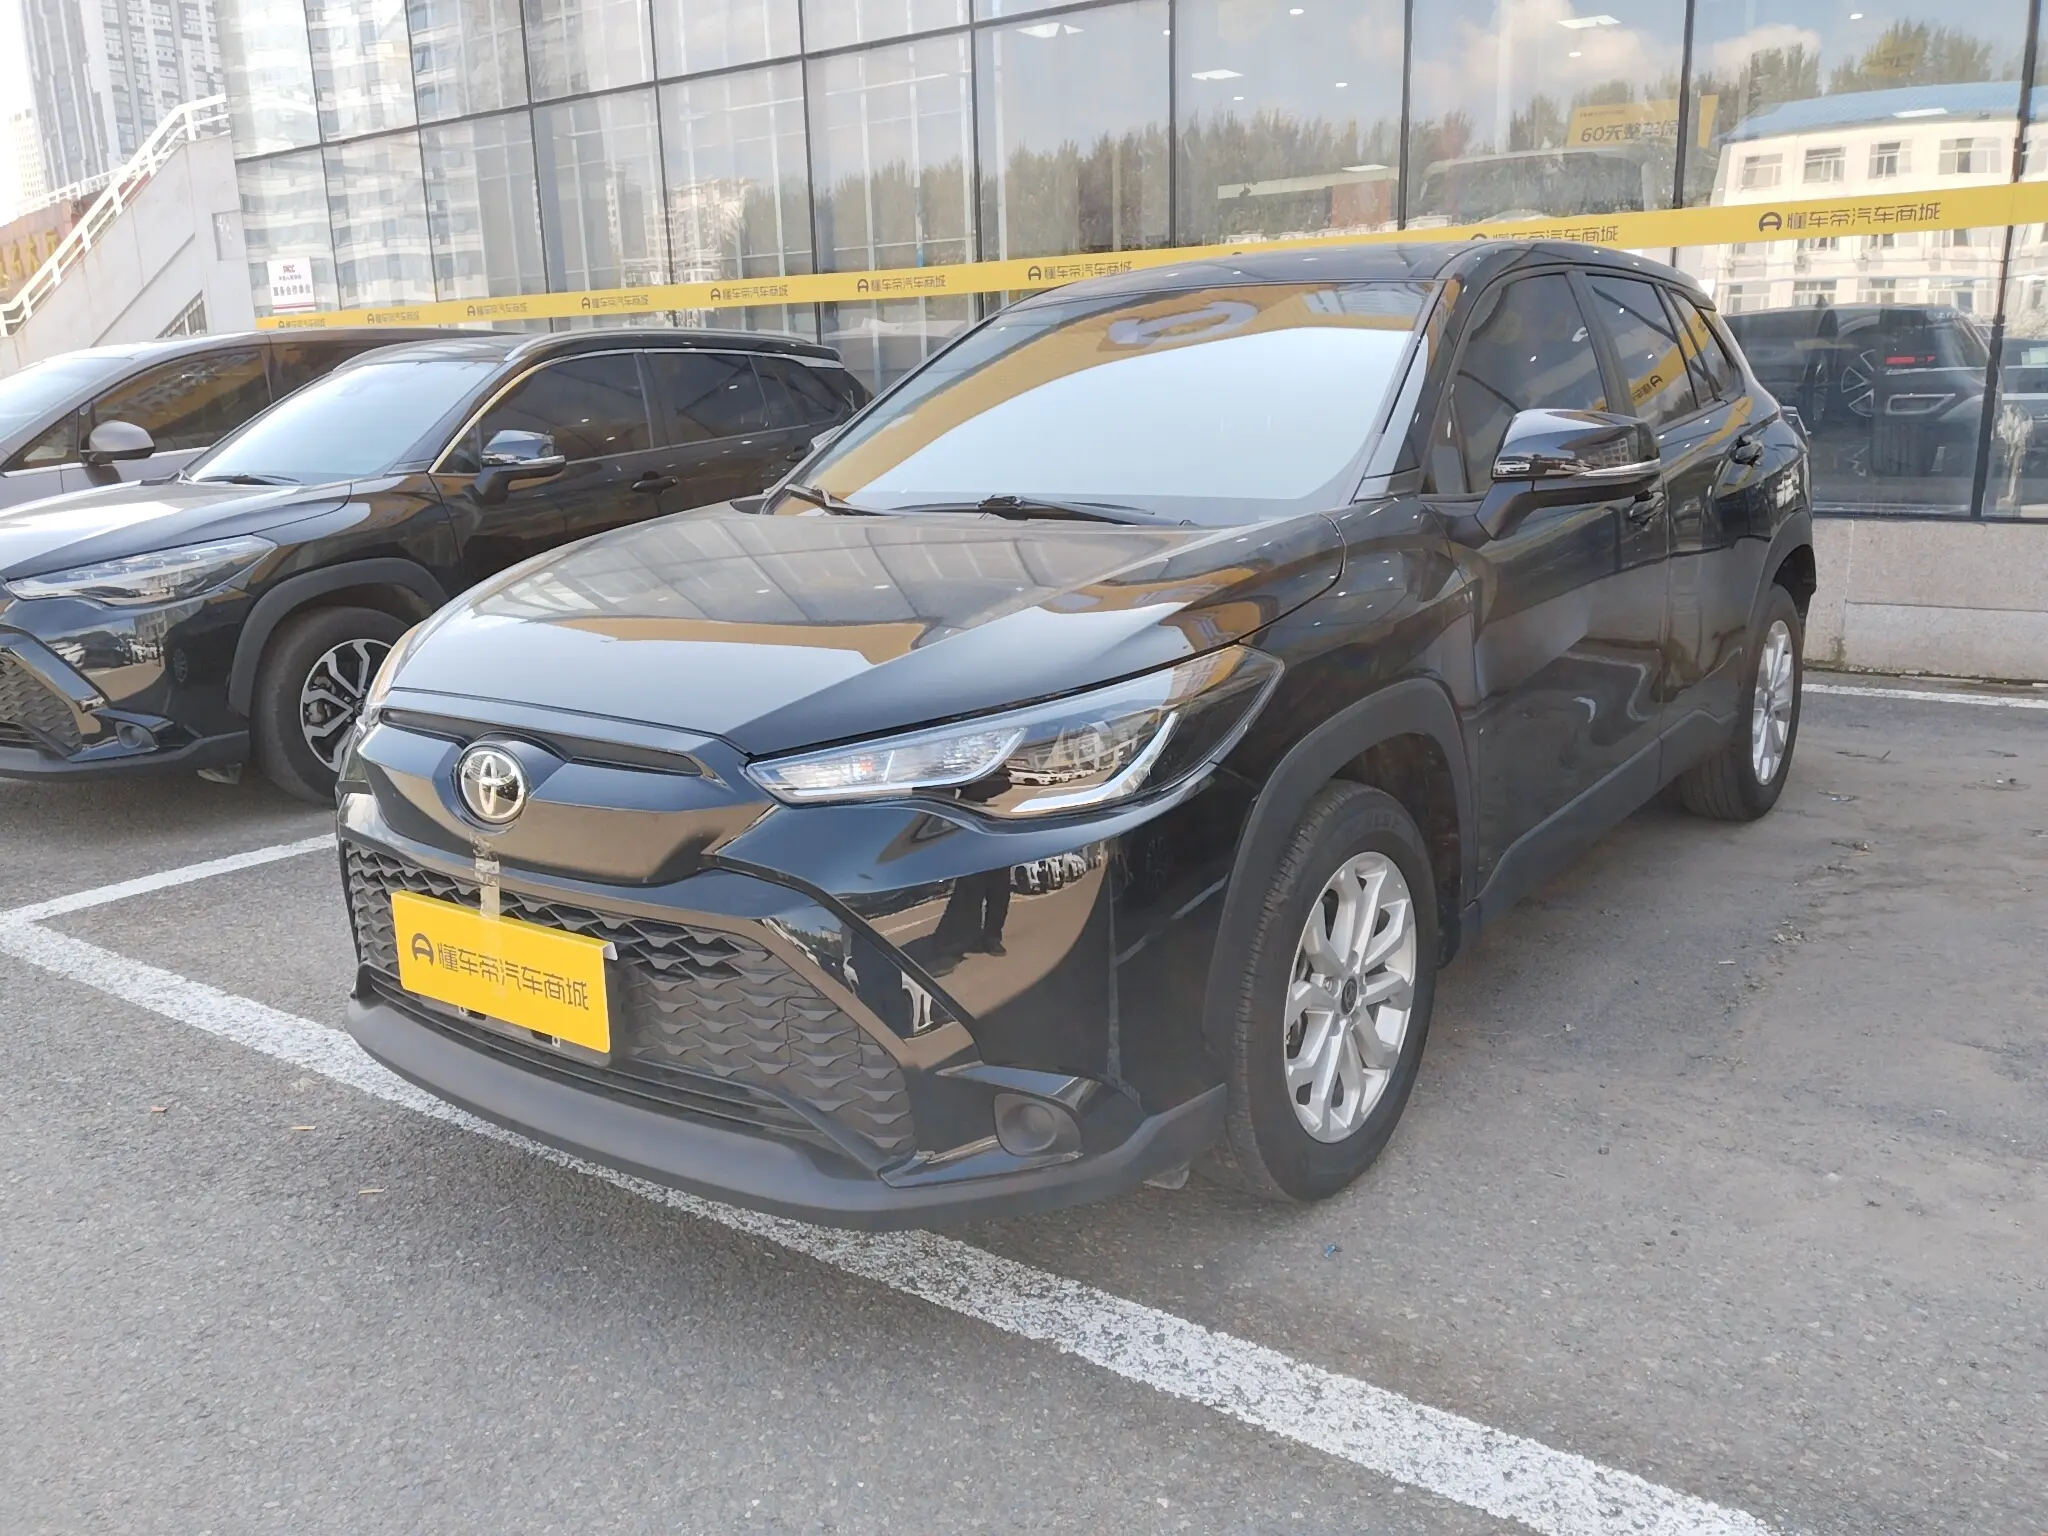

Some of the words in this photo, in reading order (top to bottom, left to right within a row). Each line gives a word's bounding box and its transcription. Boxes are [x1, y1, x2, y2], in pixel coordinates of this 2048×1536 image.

[1787, 202, 1941, 230] 懂车帝汽车商城
[871, 275, 946, 292] 懂车帝汽车商城
[437, 942, 589, 1010] 懂车帝汽车商城
